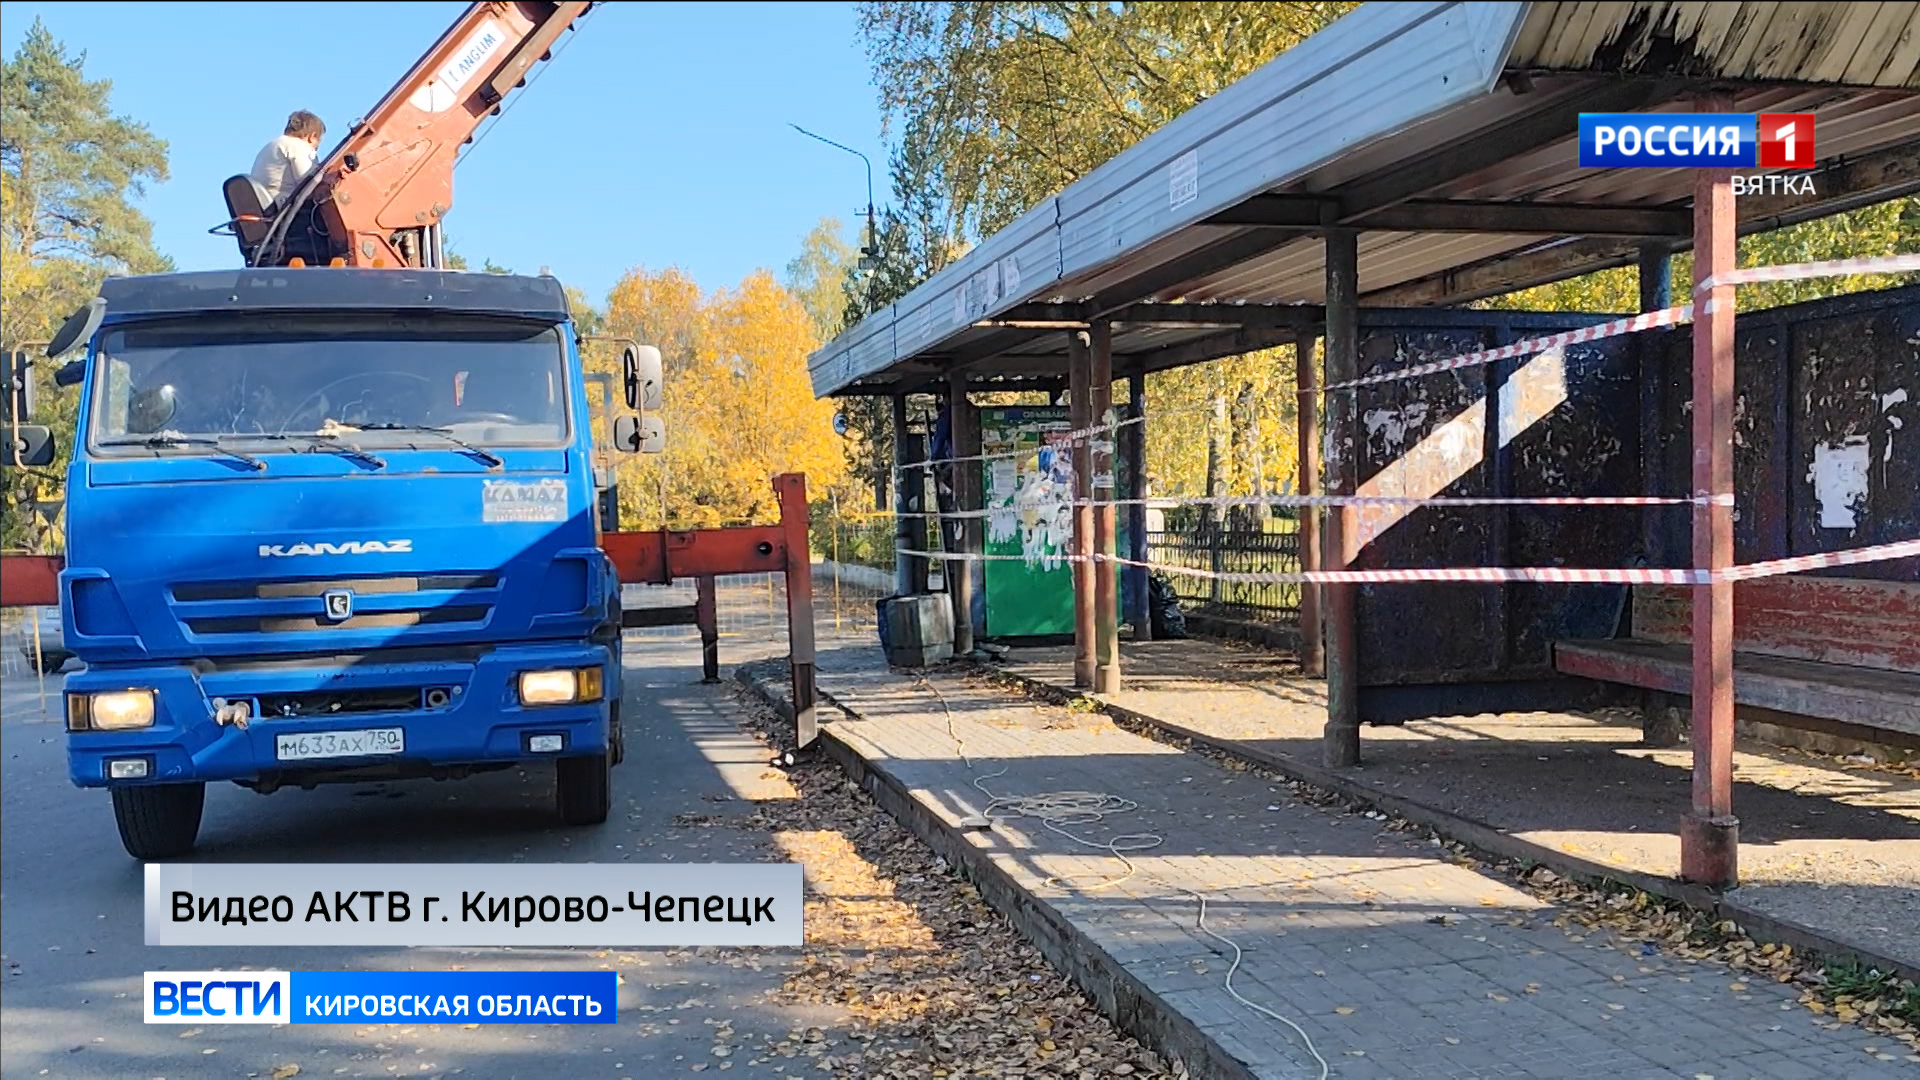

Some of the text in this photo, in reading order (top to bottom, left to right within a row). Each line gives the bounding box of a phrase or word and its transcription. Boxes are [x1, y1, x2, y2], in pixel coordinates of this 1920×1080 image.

[484, 486, 565, 503] KAMAZ
[258, 539, 412, 557] KAMAZ
[367, 730, 397, 746] 750
